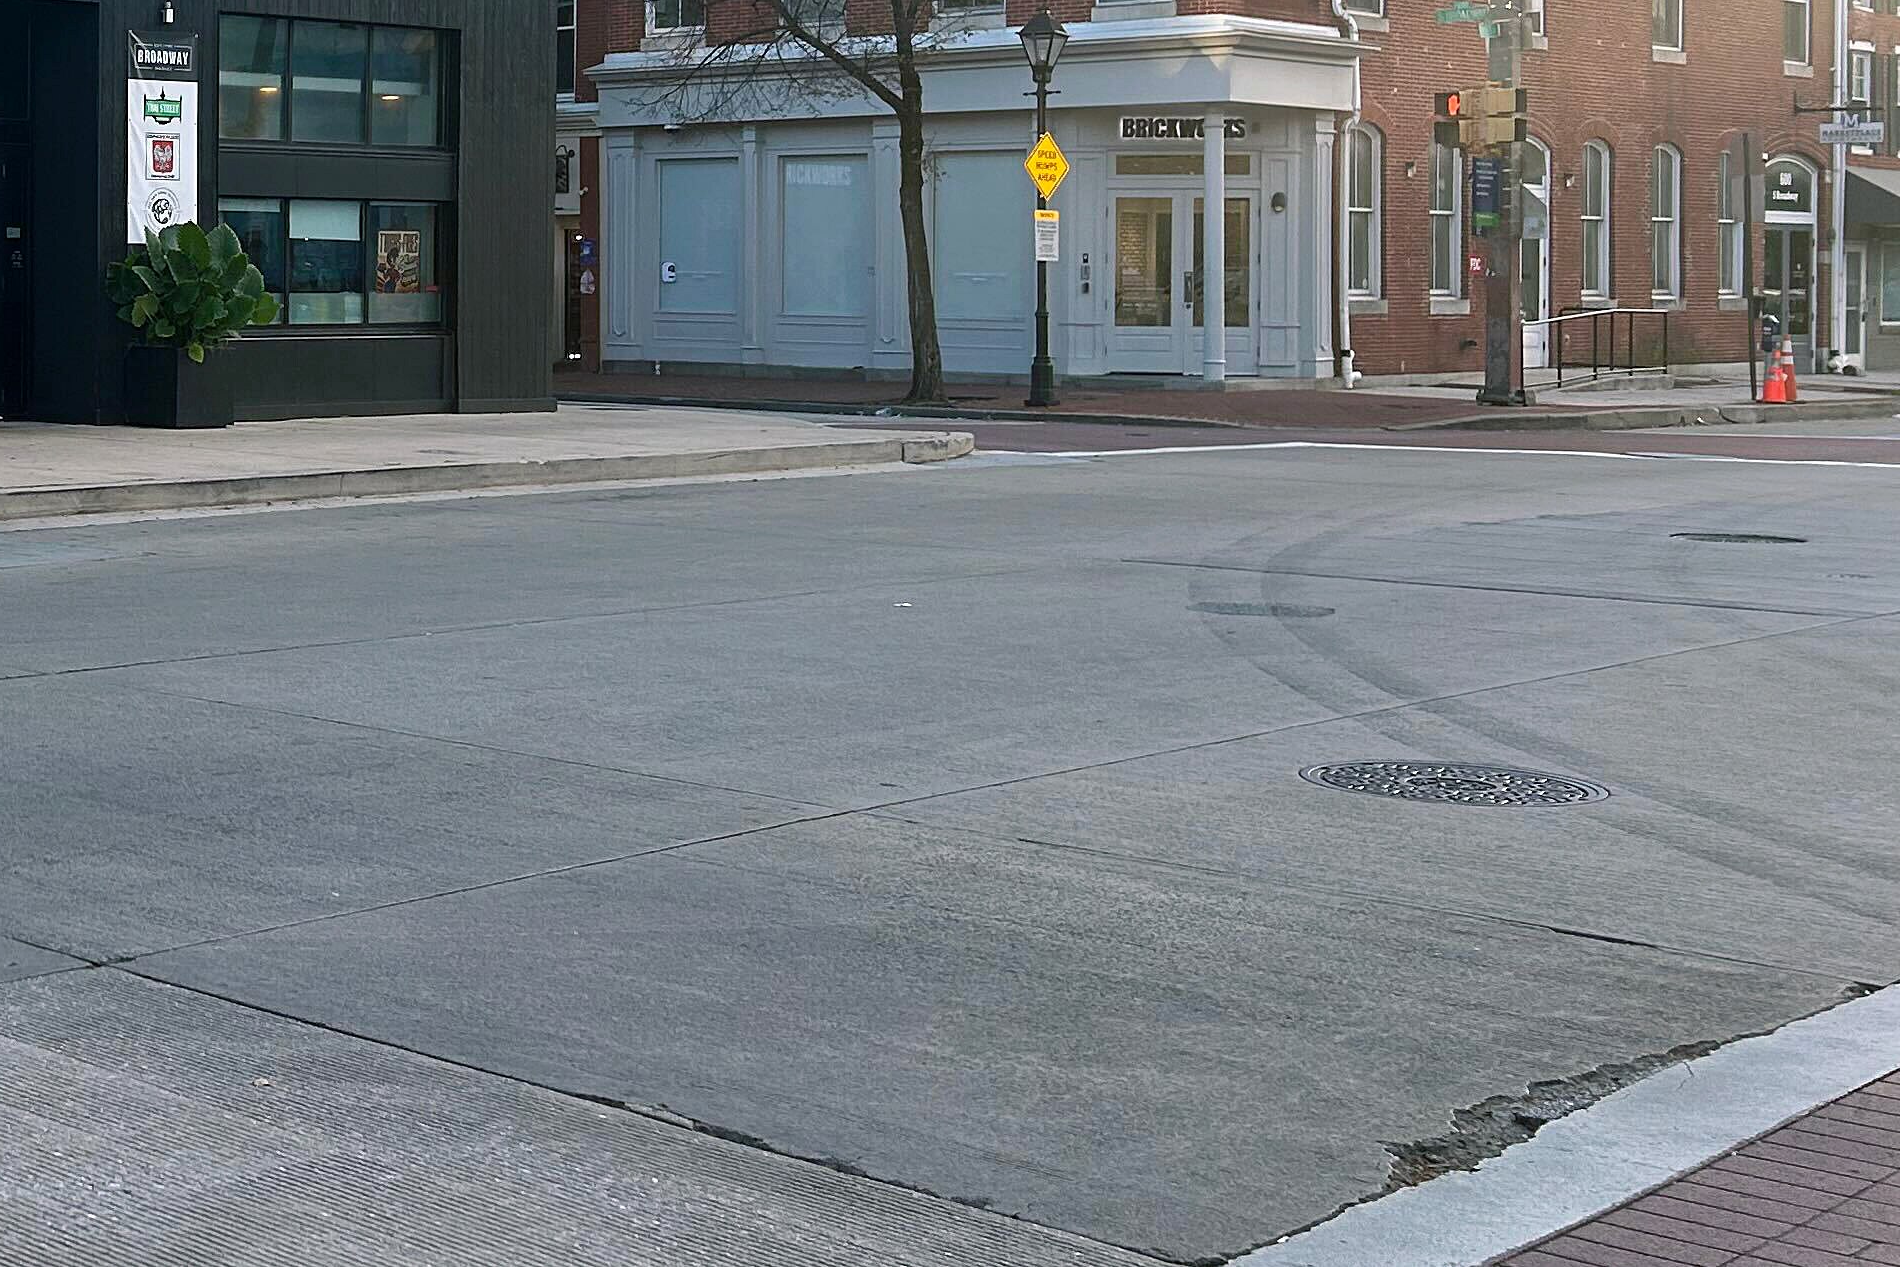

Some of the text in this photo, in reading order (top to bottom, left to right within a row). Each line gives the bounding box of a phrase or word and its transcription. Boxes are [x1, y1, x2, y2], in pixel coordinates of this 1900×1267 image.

[137, 49, 189, 66] BROADWAY
[1121, 117, 1246, 139] BRICKWOKS
[1037, 150, 1057, 160] SPEED
